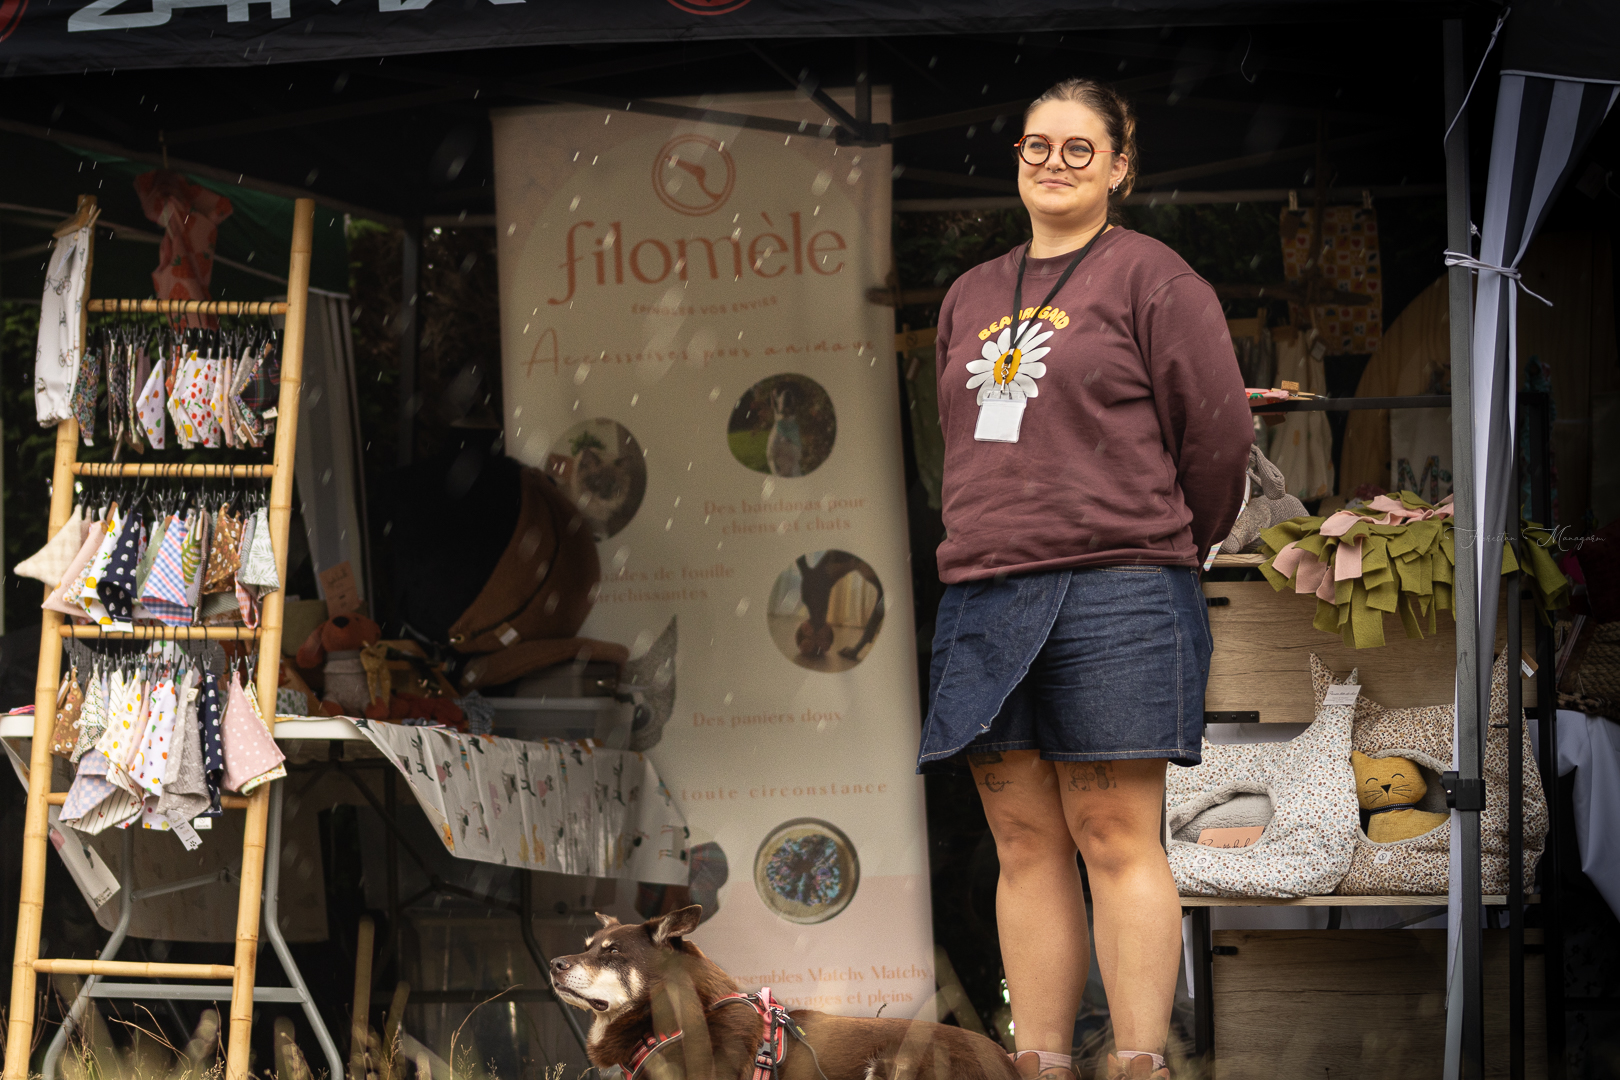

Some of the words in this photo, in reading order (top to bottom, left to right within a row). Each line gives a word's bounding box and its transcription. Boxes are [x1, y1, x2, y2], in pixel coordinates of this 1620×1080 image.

[548, 211, 847, 305] filomèle
[701, 304, 727, 315] VOS
[732, 295, 777, 313] ENVIES
[521, 327, 690, 378] Accessoires
[702, 347, 750, 367] pour
[703, 500, 736, 515] Des
[741, 498, 822, 514] bandanas
[828, 498, 866, 512] pour
[722, 520, 777, 535] chiens
[783, 519, 800, 532] et
[806, 517, 851, 531] chats
[654, 567, 675, 581] de
[681, 563, 735, 579] fouille
[692, 711, 725, 728] Des
[731, 710, 795, 729] paniers
[801, 707, 842, 724] doux
[681, 786, 739, 801] toute
[749, 781, 888, 799] circonstance
[808, 966, 865, 984] Matchy
[784, 992, 842, 1009] oyages
[847, 991, 863, 1005] et
[868, 990, 914, 1008] pleins
